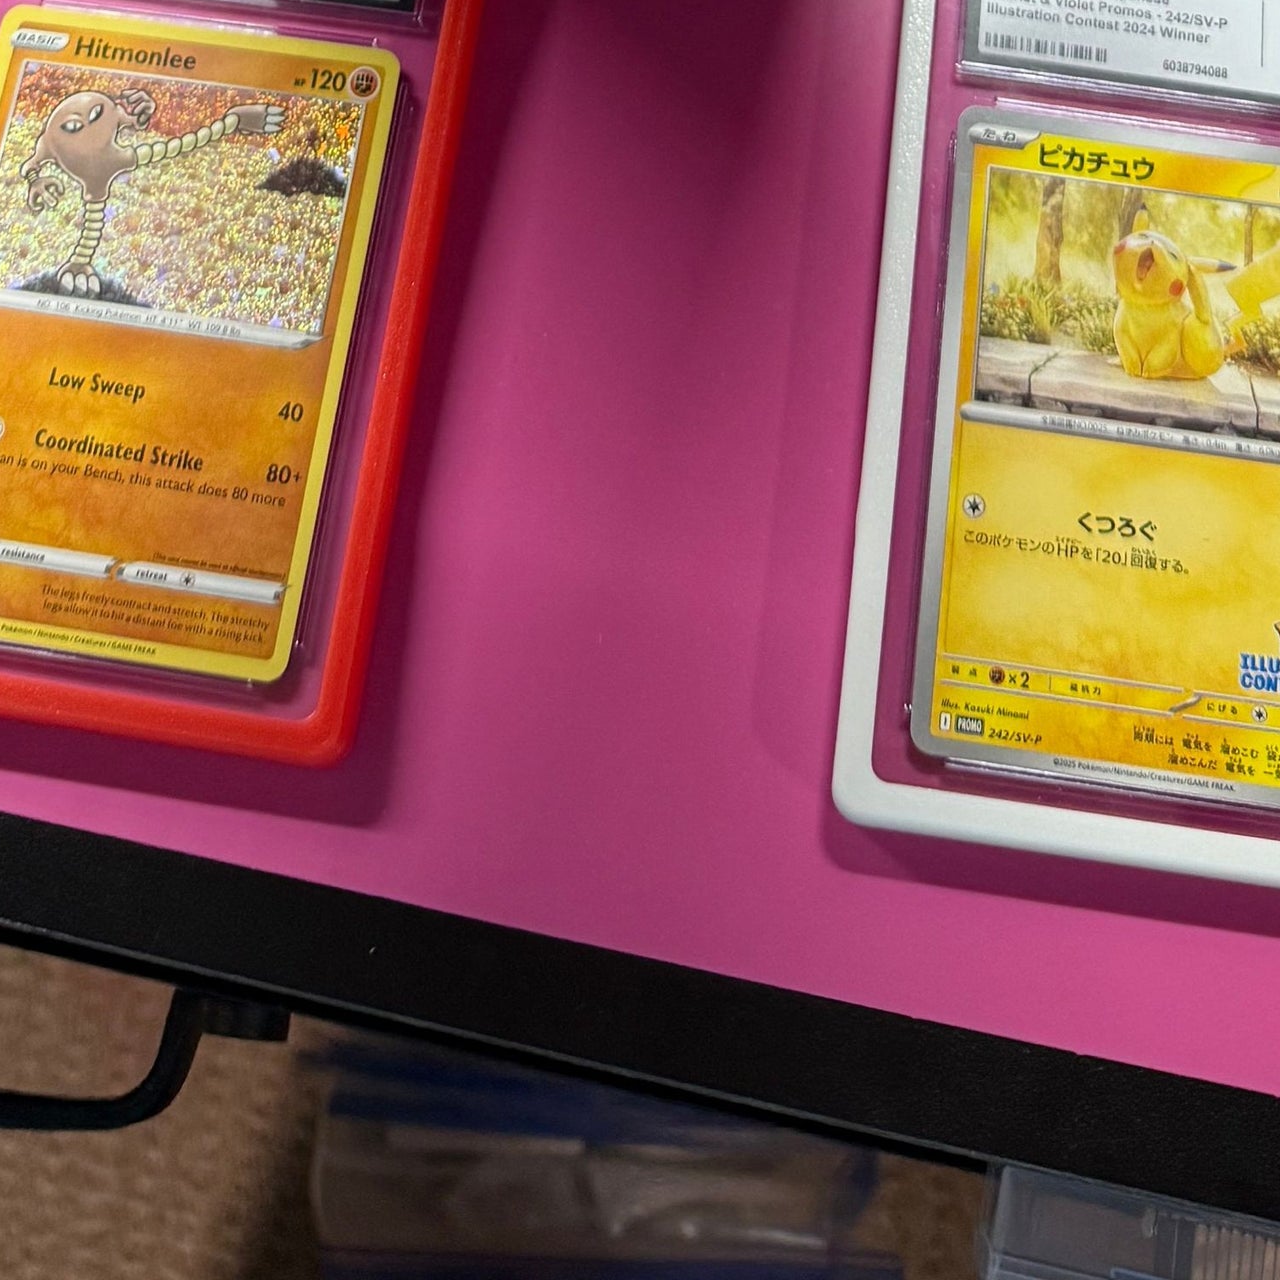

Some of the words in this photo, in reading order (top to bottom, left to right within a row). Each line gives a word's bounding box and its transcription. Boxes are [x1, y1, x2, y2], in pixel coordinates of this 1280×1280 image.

[987, 1, 1061, 24] Illustration
[1065, 12, 1120, 32] Contest
[1123, 20, 1157, 37] 2024
[1160, 26, 1211, 45] Winner
[1098, 2, 1153, 20] Promos
[1165, 10, 1229, 30] 242/SV-P
[14, 32, 62, 47] BASIC
[74, 36, 197, 71] Hitmonlee
[310, 67, 347, 93] 120
[1162, 58, 1229, 79] 6038794088
[982, 128, 1016, 143] たね
[1039, 143, 1155, 181] ピカチュウ
[48, 366, 85, 391] Low
[90, 372, 146, 405] Sweep
[278, 401, 304, 424] 40
[35, 427, 147, 466] Coordinated
[150, 444, 204, 472] Strike
[17, 453, 28, 468] is
[30, 458, 48, 472] on
[49, 462, 80, 477] your
[83, 464, 125, 485] Bench,
[129, 471, 152, 487] this
[155, 476, 194, 494] attack
[197, 483, 228, 500] does
[231, 487, 249, 502] 80
[251, 492, 287, 508] more
[266, 463, 302, 485] 80+
[1077, 511, 1158, 542] くつろぐ
[0, 545, 46, 563] resistance
[136, 567, 169, 582] retreat
[42, 583, 60, 597] The
[60, 587, 81, 603] legs
[81, 591, 111, 607] freely
[110, 596, 152, 612] contract
[152, 602, 172, 615] and
[171, 605, 208, 621] stretch.
[210, 611, 229, 625] The
[228, 615, 270, 632] stretchy
[42, 600, 63, 615] legs
[63, 603, 89, 618] allow
[88, 607, 99, 619] it
[99, 609, 111, 620] to
[111, 610, 124, 622] hit
[131, 614, 166, 629] distant
[167, 618, 185, 631] foe
[184, 621, 207, 635] with
[213, 626, 244, 643] rising
[1206, 702, 1238, 716] にげる
[956, 717, 983, 735] PROMO
[988, 727, 1043, 745] 242/SV-P
